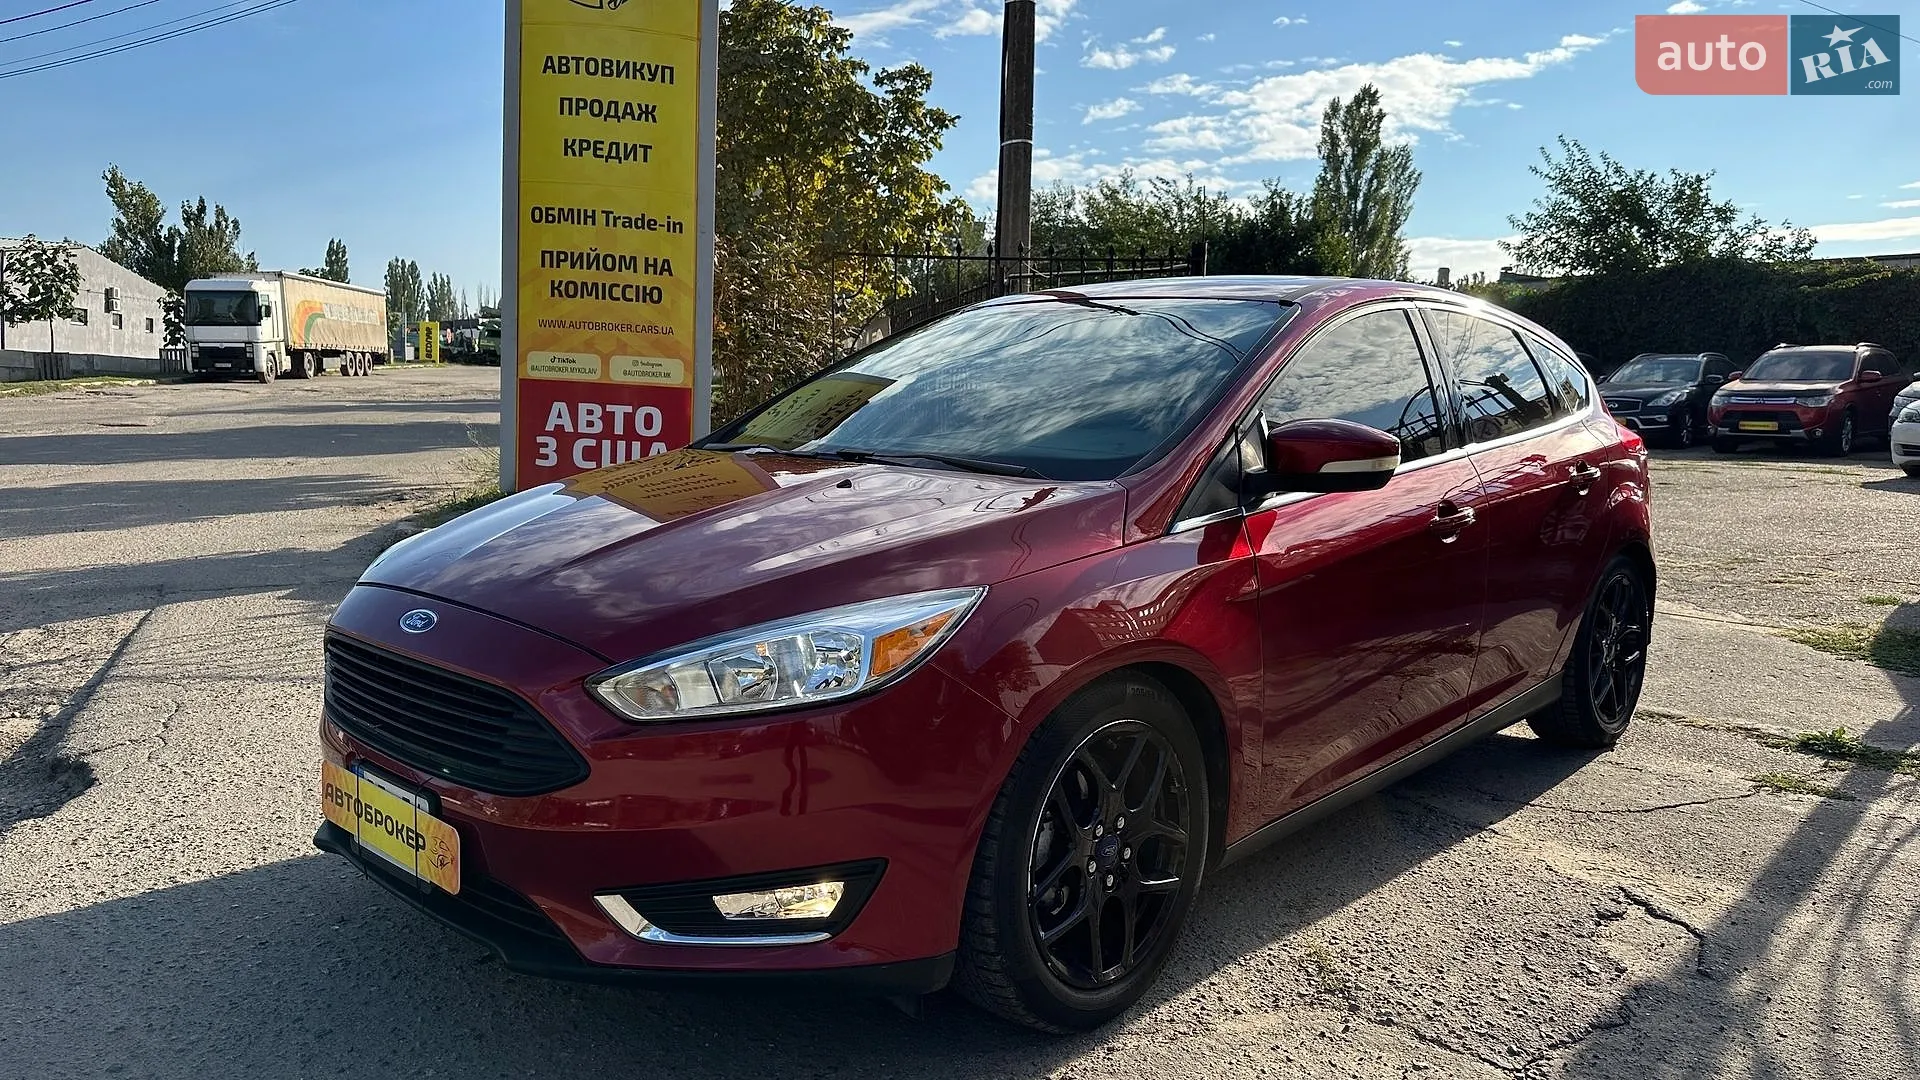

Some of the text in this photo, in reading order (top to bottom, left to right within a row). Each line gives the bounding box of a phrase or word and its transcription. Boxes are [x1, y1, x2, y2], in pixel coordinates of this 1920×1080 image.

[542, 55, 675, 85] АВТОВИКУП
[559, 97, 658, 123] ПРОДАЖ
[563, 138, 653, 164] КРЕДИТ
[530, 206, 684, 234] ОБМІН Trade-in
[540, 247, 674, 277] ПРИЙОМ НА
[550, 279, 663, 305] КОМІССІЮ
[538, 318, 675, 336] WWW.AUTOBROKER.CARS.UA
[545, 401, 663, 437] АВТО
[325, 782, 427, 852] АВТОБРОКЕР
